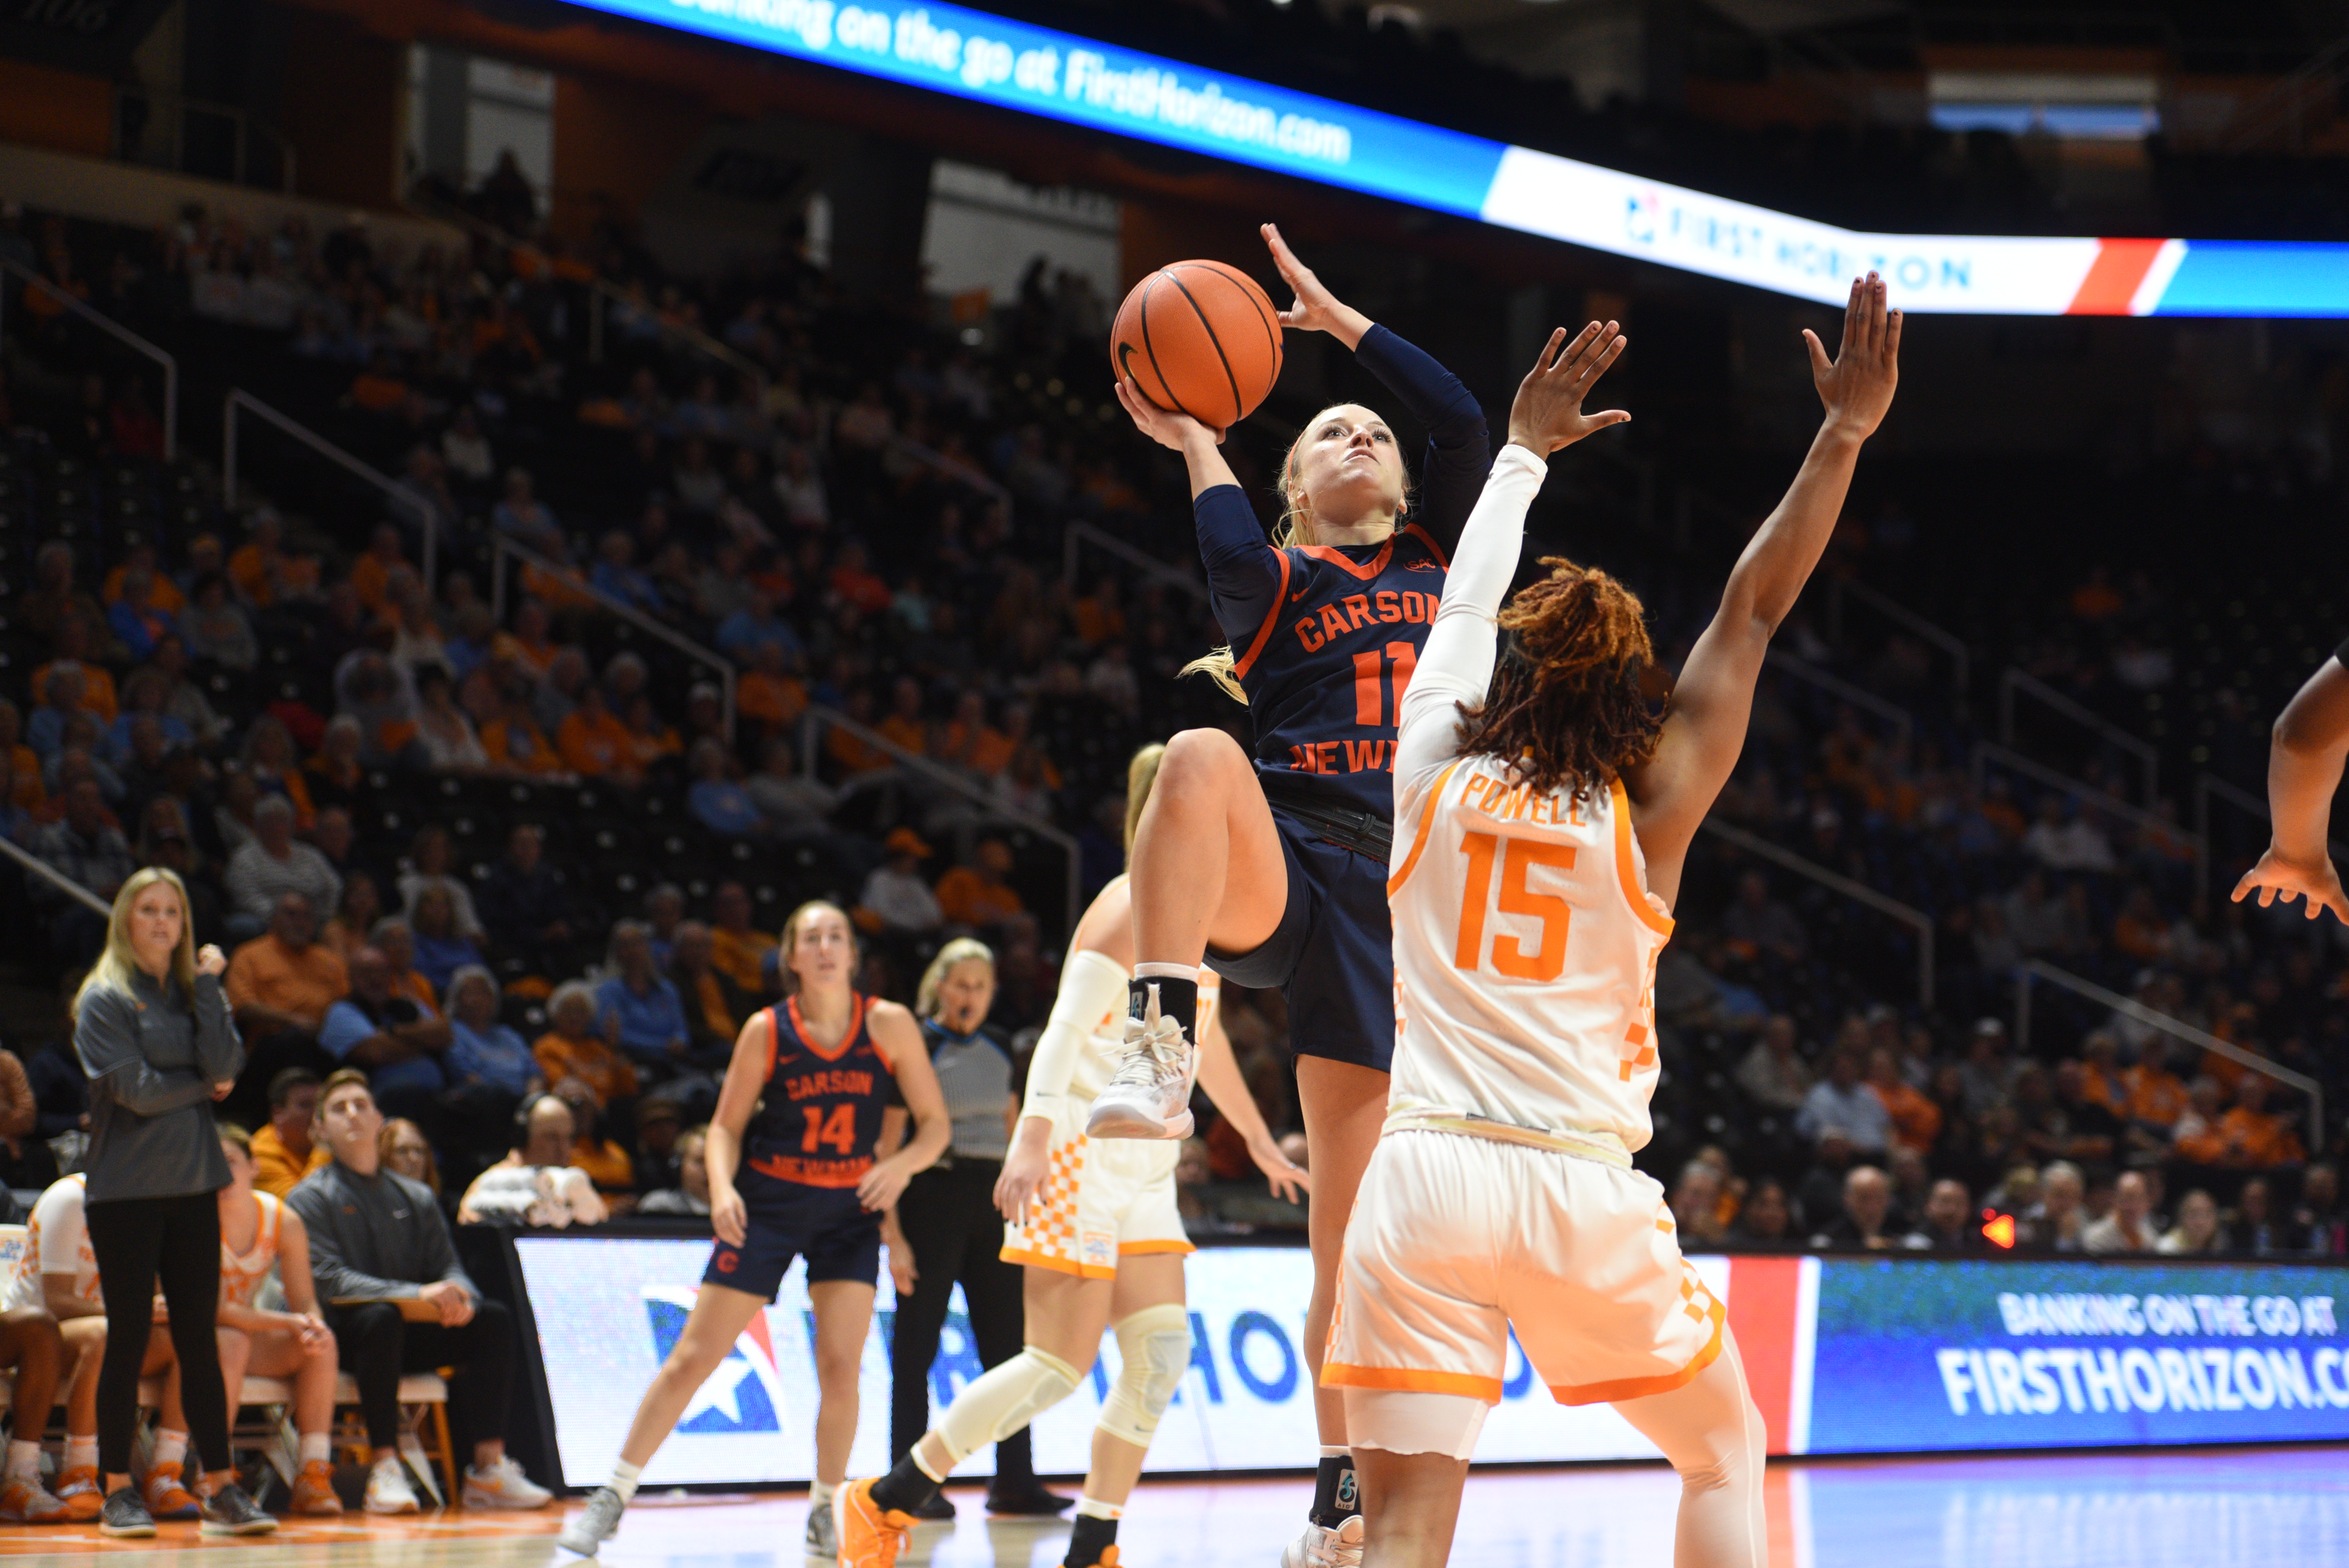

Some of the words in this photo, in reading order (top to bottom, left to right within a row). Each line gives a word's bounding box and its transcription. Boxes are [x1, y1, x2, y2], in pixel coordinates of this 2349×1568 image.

[671, 0, 836, 50] king
[836, 6, 892, 55] on
[894, 9, 962, 72] the
[960, 36, 1014, 88] go
[1014, 46, 1060, 96] at
[1063, 49, 1351, 165] FirstHorizon.com
[1289, 739, 1399, 776] NEW
[1460, 772, 1586, 827] POWELL
[1454, 831, 1578, 983] 15
[785, 1070, 874, 1100] CARSON
[801, 1102, 856, 1154] 14
[1998, 1292, 2147, 1336] BANKING
[2143, 1293, 2198, 1336] ON
[2189, 1294, 2257, 1336] THE
[2252, 1295, 2301, 1336] GO
[2301, 1296, 2338, 1336] AT
[1937, 1347, 2349, 1416] FIRSTHORIZON.C
